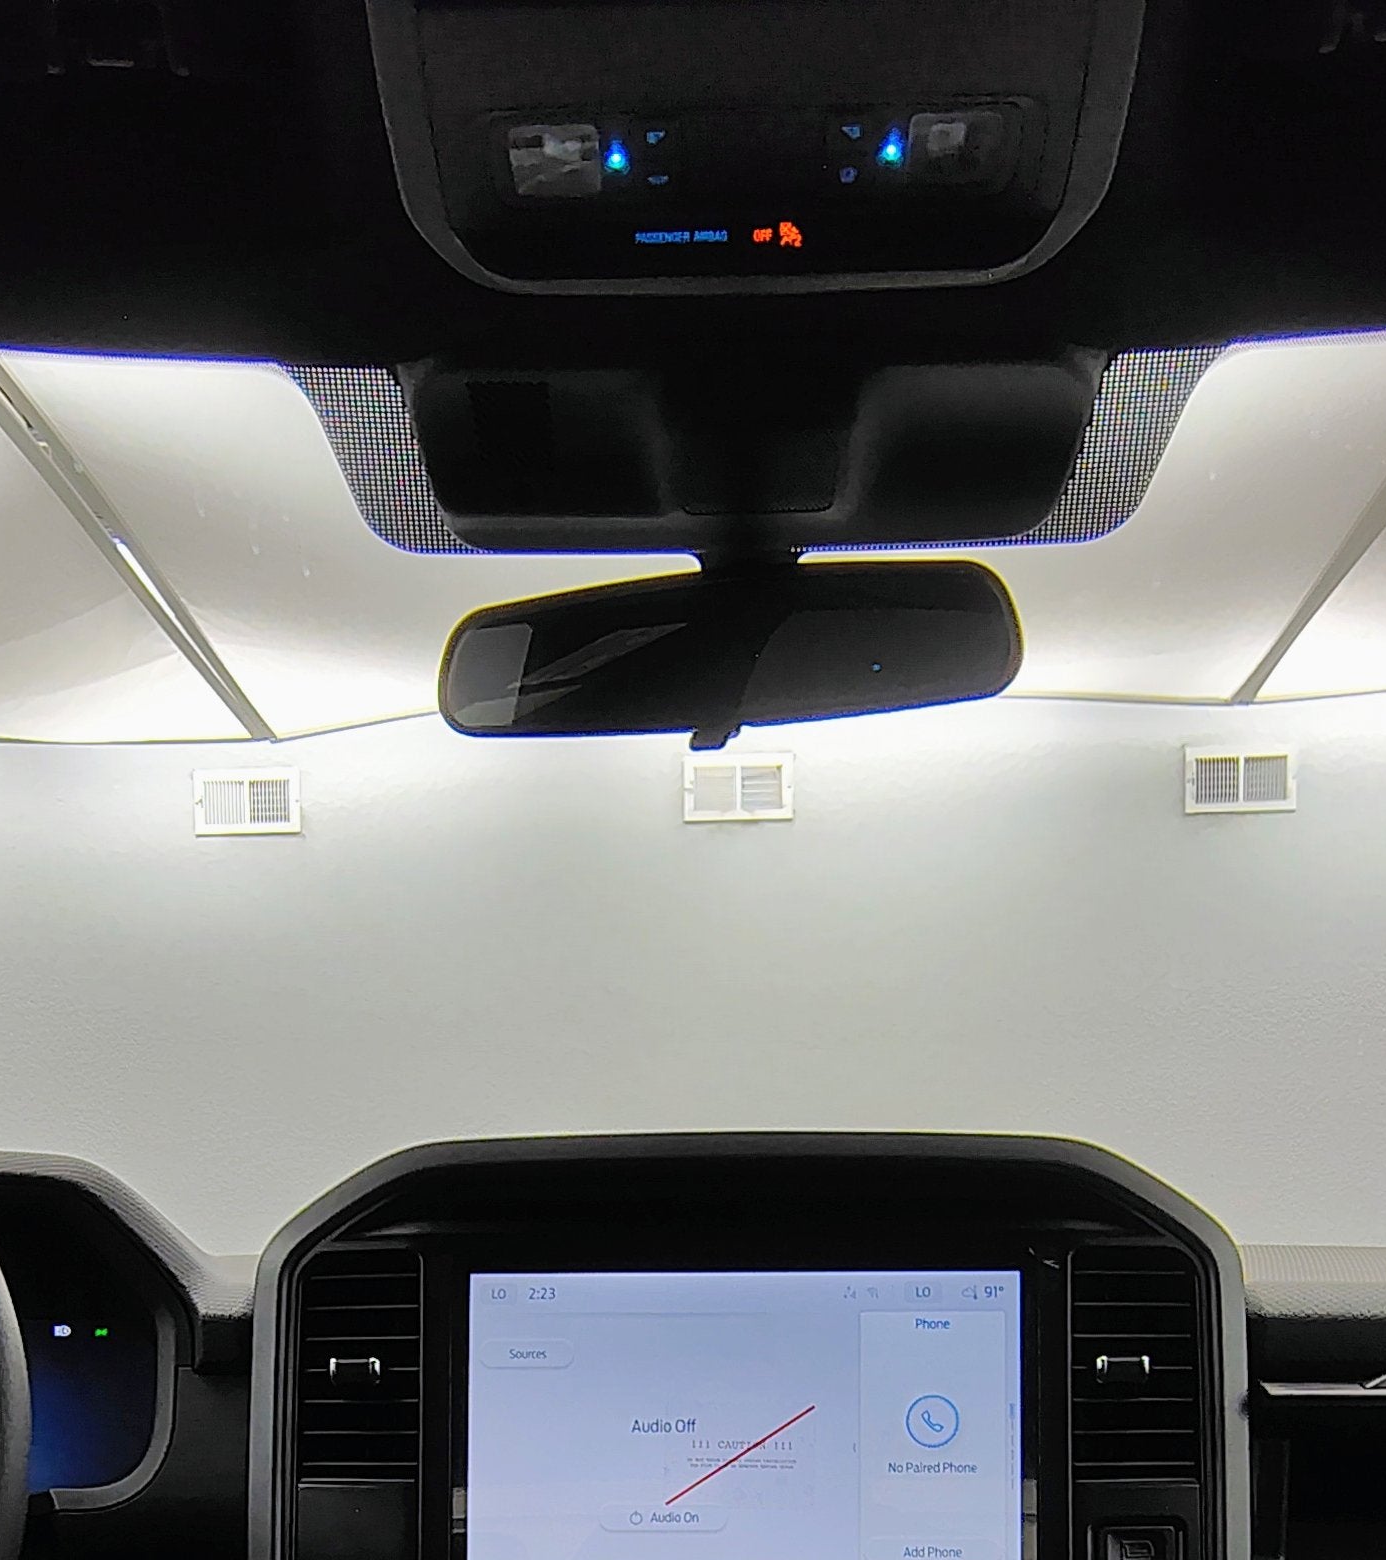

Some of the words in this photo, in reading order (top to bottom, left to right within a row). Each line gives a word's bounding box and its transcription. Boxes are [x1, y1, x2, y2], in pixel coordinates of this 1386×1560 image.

[635, 231, 690, 244] PASSENGER
[753, 228, 773, 242] OFF
[491, 1289, 506, 1300] LO
[528, 1288, 556, 1300] 2:23
[915, 1286, 931, 1298] LO
[984, 1286, 1005, 1298] 91°
[915, 1318, 950, 1330] Phone
[509, 1349, 547, 1360] Sources
[631, 1420, 672, 1433] Audio
[675, 1419, 696, 1433] Off
[717, 1441, 766, 1450] CAUTIN
[888, 1462, 904, 1473] No
[906, 1462, 940, 1473] Paired
[943, 1462, 978, 1473] Phone
[650, 1512, 681, 1523] Audio
[684, 1511, 700, 1523] On
[903, 1547, 925, 1558] Add
[927, 1546, 963, 1558] Phone
